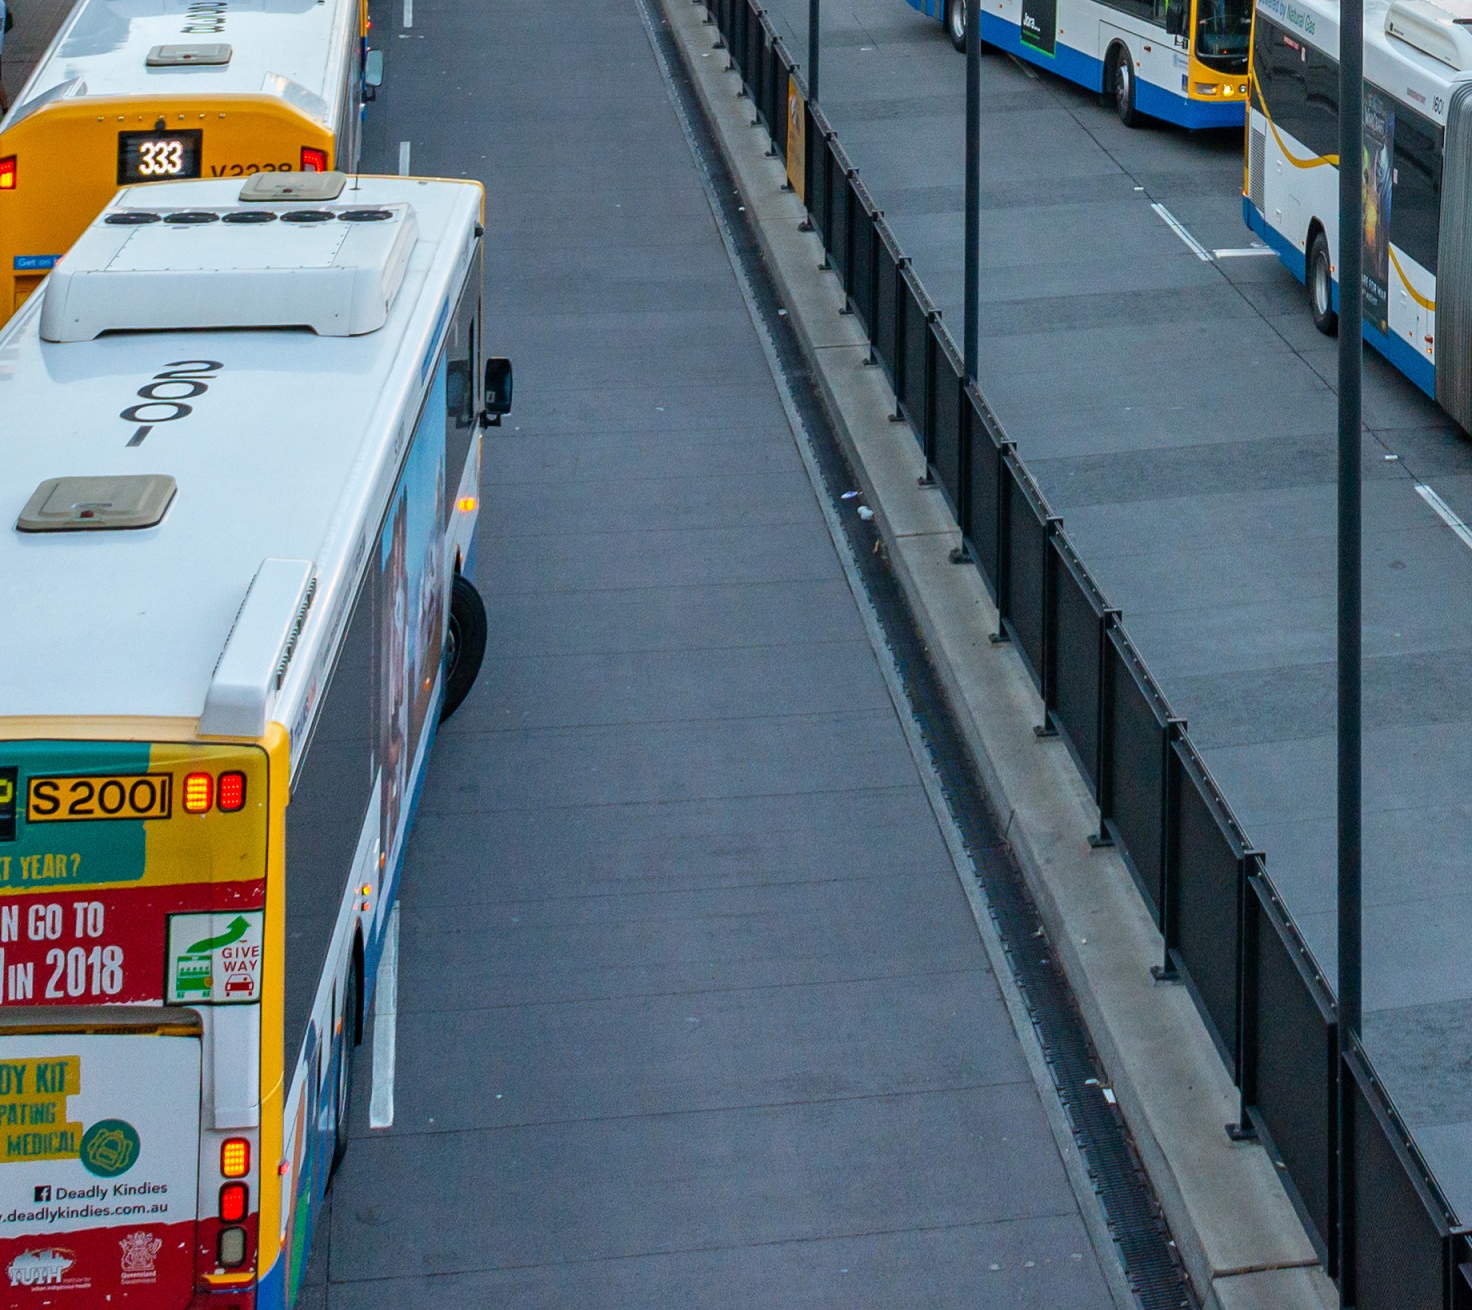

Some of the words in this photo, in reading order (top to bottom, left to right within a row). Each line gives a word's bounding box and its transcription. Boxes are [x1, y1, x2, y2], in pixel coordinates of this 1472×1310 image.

[1286, 3, 1304, 29] Natural
[1305, 14, 1315, 35] Gas
[1432, 95, 1445, 116] 1601
[139, 141, 184, 175] 333
[18, 256, 37, 268] Get
[39, 257, 50, 267] on
[29, 903, 63, 941] GO
[73, 901, 105, 938] TO
[221, 944, 260, 960] GIVE
[8, 962, 34, 1001] IN
[45, 946, 125, 999] 2018
[223, 959, 258, 973] WAY
[35, 1061, 69, 1094] KIT
[7, 1131, 80, 1157] MEDICAL
[56, 1186, 108, 1201] Deadly
[113, 1182, 168, 1197] Kindies
[8, 1265, 62, 1286] IUIH
